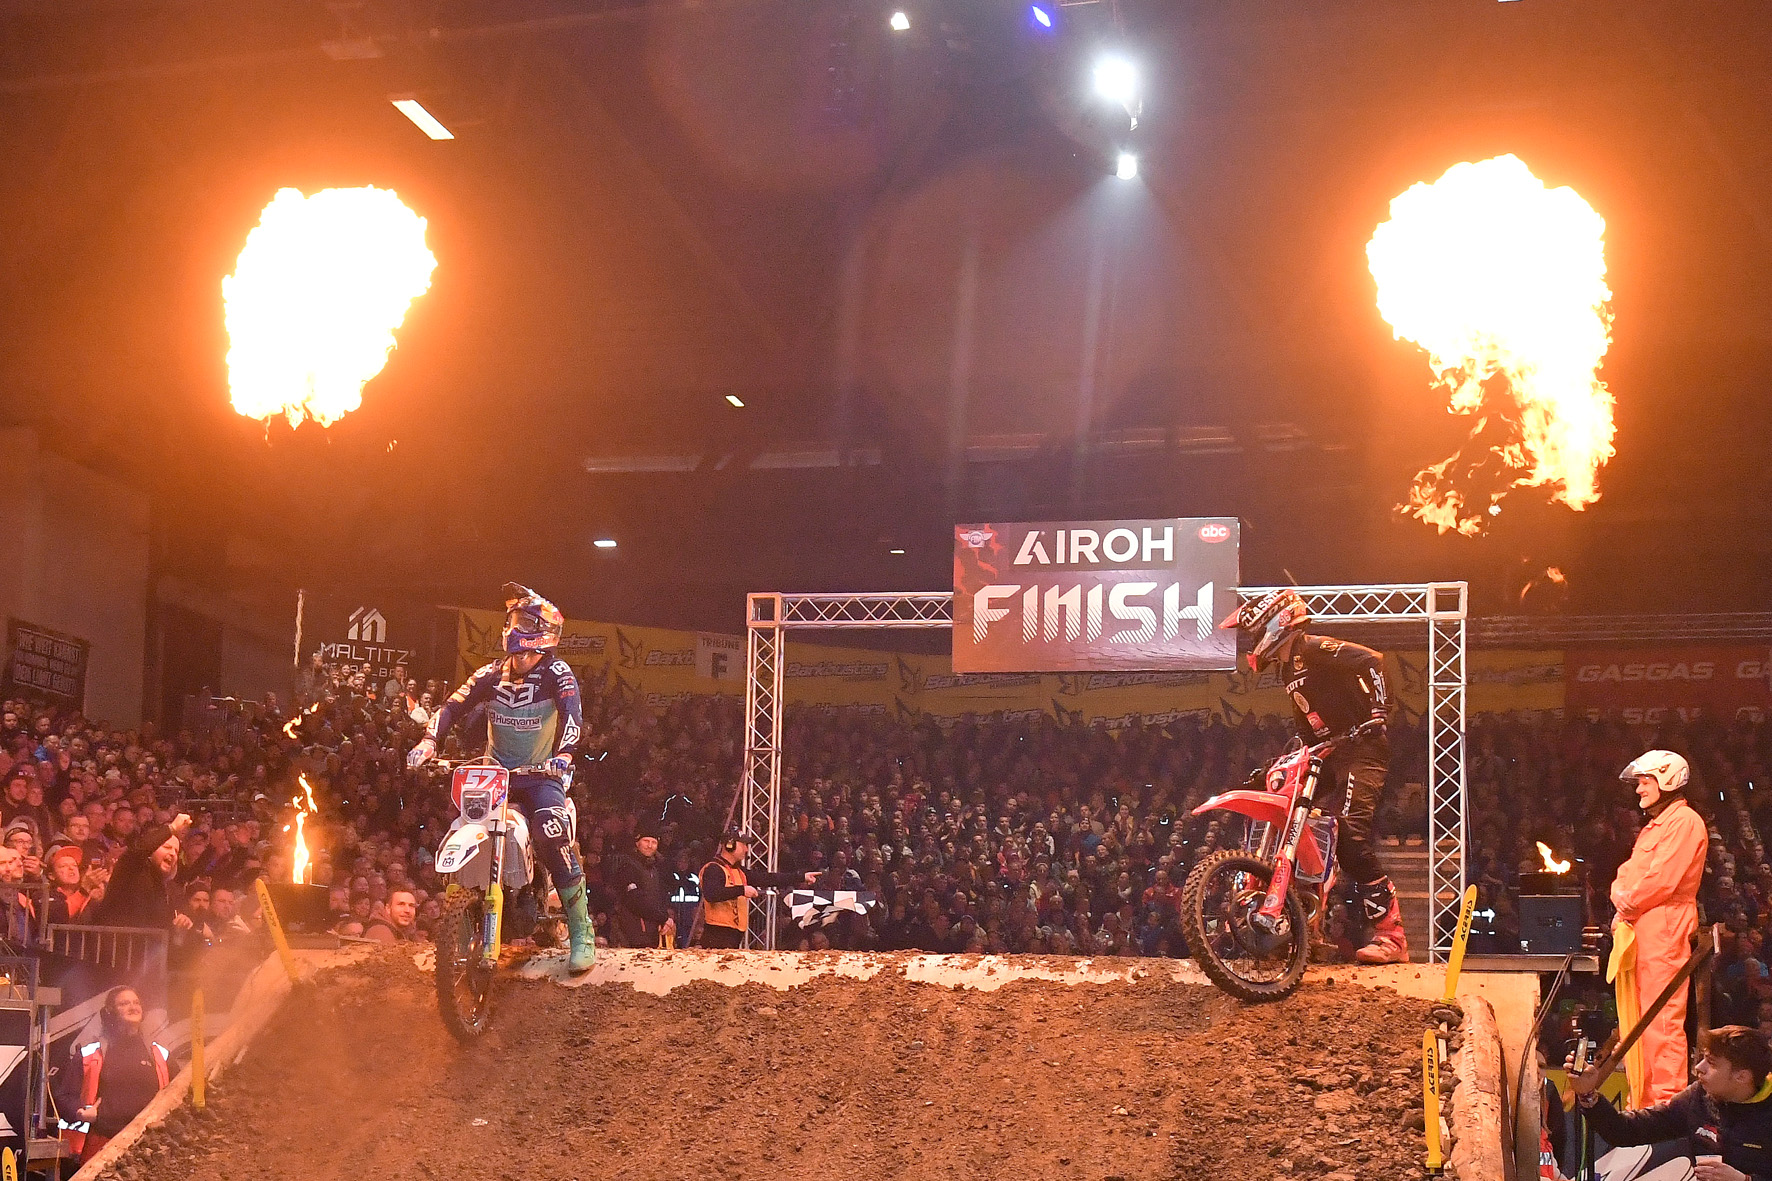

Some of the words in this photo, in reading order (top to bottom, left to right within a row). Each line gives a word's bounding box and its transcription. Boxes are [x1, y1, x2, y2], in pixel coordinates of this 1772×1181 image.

[1200, 524, 1227, 538] abc
[1013, 526, 1174, 565] AIROH
[973, 581, 1214, 644] FINISH
[320, 642, 409, 665] MALTITZ
[710, 652, 728, 679] F
[785, 661, 889, 678] Barkbusters
[1576, 662, 1715, 684] GASGAS
[496, 714, 541, 726] Husqvarna
[463, 769, 498, 789] 57
[1460, 899, 1474, 942] ACERBIS
